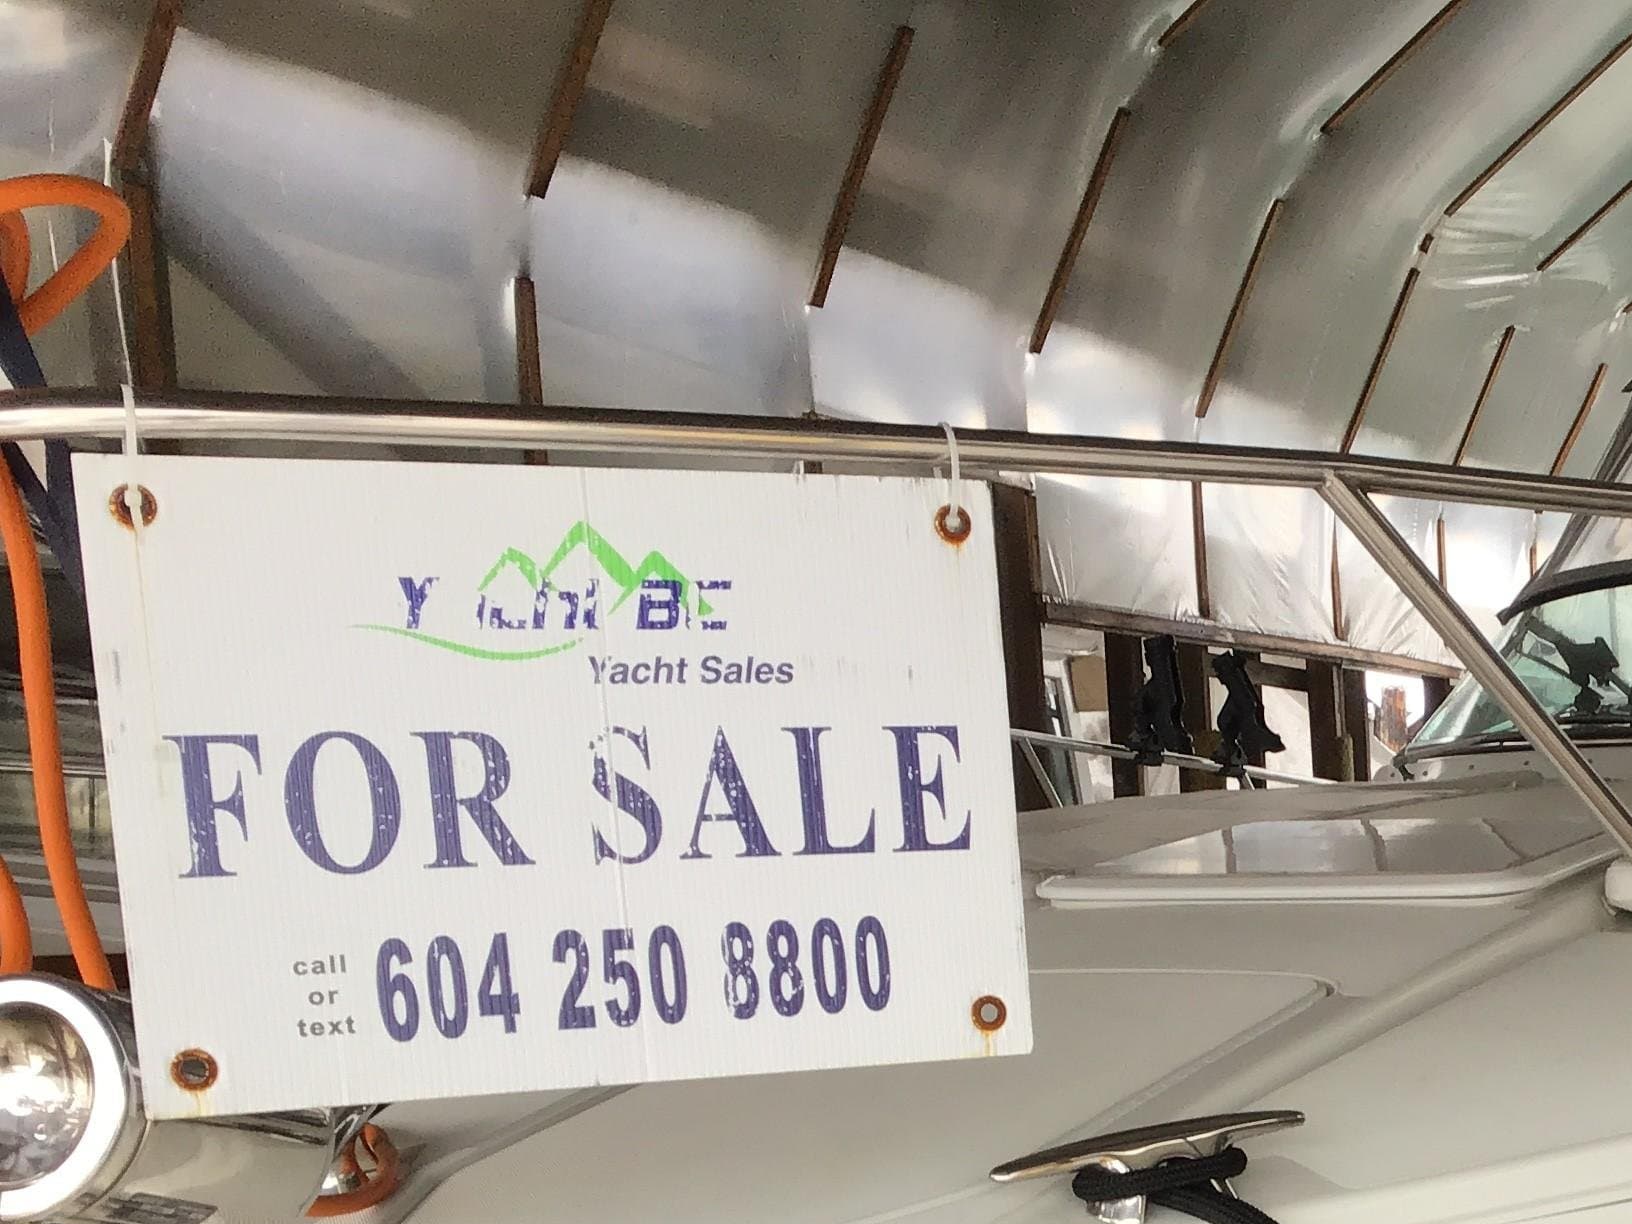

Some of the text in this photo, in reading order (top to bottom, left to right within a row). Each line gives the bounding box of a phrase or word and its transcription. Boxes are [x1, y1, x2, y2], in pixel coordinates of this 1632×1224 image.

[588, 655, 794, 684] Yacht Sales
[163, 724, 972, 879] FOR SALE
[293, 953, 348, 976] call
[376, 915, 891, 1043] 604 250 8800
[308, 988, 339, 1006] or
[297, 1016, 356, 1036] text
